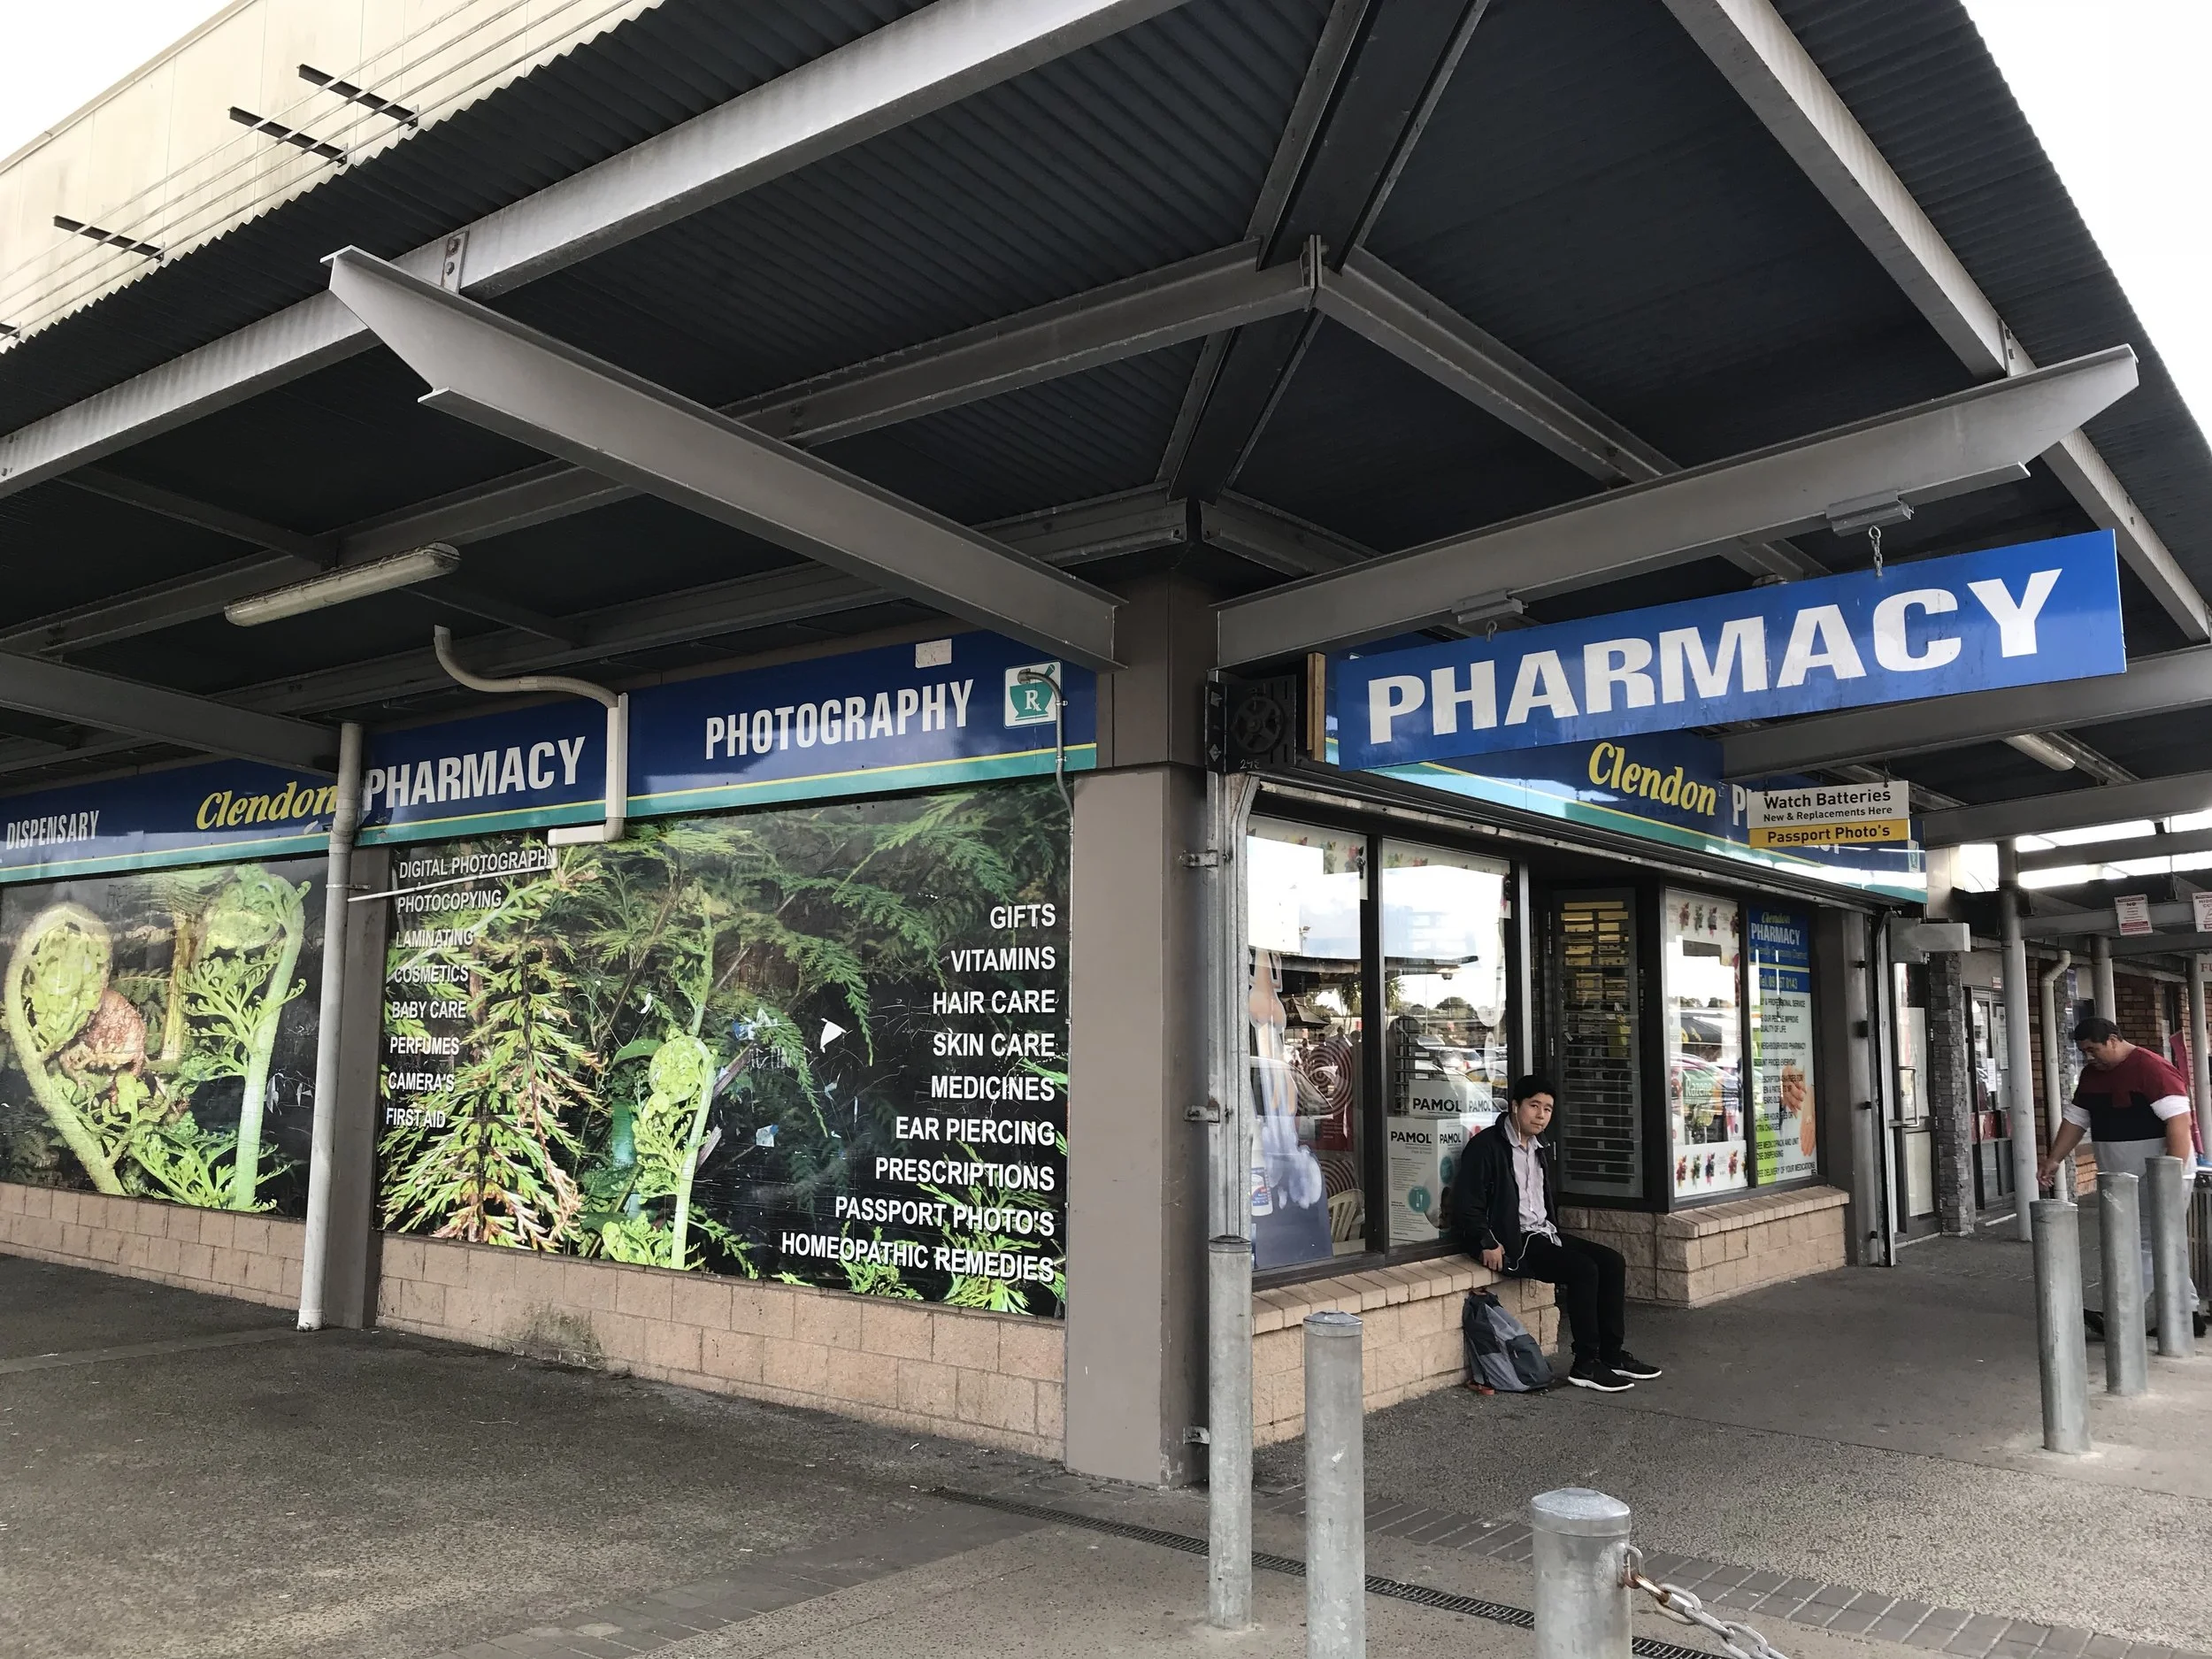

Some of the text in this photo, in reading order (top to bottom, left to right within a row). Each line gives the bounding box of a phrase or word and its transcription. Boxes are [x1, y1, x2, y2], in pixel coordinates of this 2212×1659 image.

[1368, 568, 2063, 744] PHARMACY
[705, 679, 974, 760] PHOTOGRAPHY
[364, 736, 586, 811] PHARMACY
[1588, 741, 1717, 817] Clendon
[196, 781, 338, 830] Clendon
[1763, 789, 1892, 810] Watch Batteries
[1763, 813, 1784, 822] New
[1796, 808, 1866, 821] Replacements
[1868, 806, 1893, 815] Here
[5, 810, 99, 850] DISPENSARY
[1768, 825, 1891, 843] Passport Photo's
[399, 859, 448, 879] DIGITAL
[397, 889, 502, 913] PHOTOCOPYING
[989, 902, 1056, 929] GIFTS
[396, 929, 474, 949] LAMINATING
[1751, 922, 1801, 946] PHARMACY
[950, 946, 1056, 972] VITAMINS
[394, 964, 469, 985] COSMETICS
[392, 1001, 467, 1019] BABY CARE
[933, 989, 1056, 1015] HAIR CARE
[389, 1036, 460, 1056] PERFUMES
[933, 1033, 1056, 1057] SKIN CARE
[388, 1071, 455, 1093] CAMERA'S
[931, 1075, 1056, 1102] MEDICINES
[1412, 1098, 1463, 1112] PAMOL
[1469, 1100, 1491, 1112] PAMOL
[386, 1107, 446, 1129] FIRST AID
[895, 1116, 1056, 1146] EAR PIERCING
[1390, 1131, 1432, 1144] PAMOL
[1440, 1133, 1462, 1144] PAMOL
[875, 1156, 1056, 1192] PRESCRIPTIONS
[835, 1195, 1055, 1237] PASSPORT PHOTO'S
[781, 1232, 1055, 1283] HOMEOPATHIC REMEDIES
